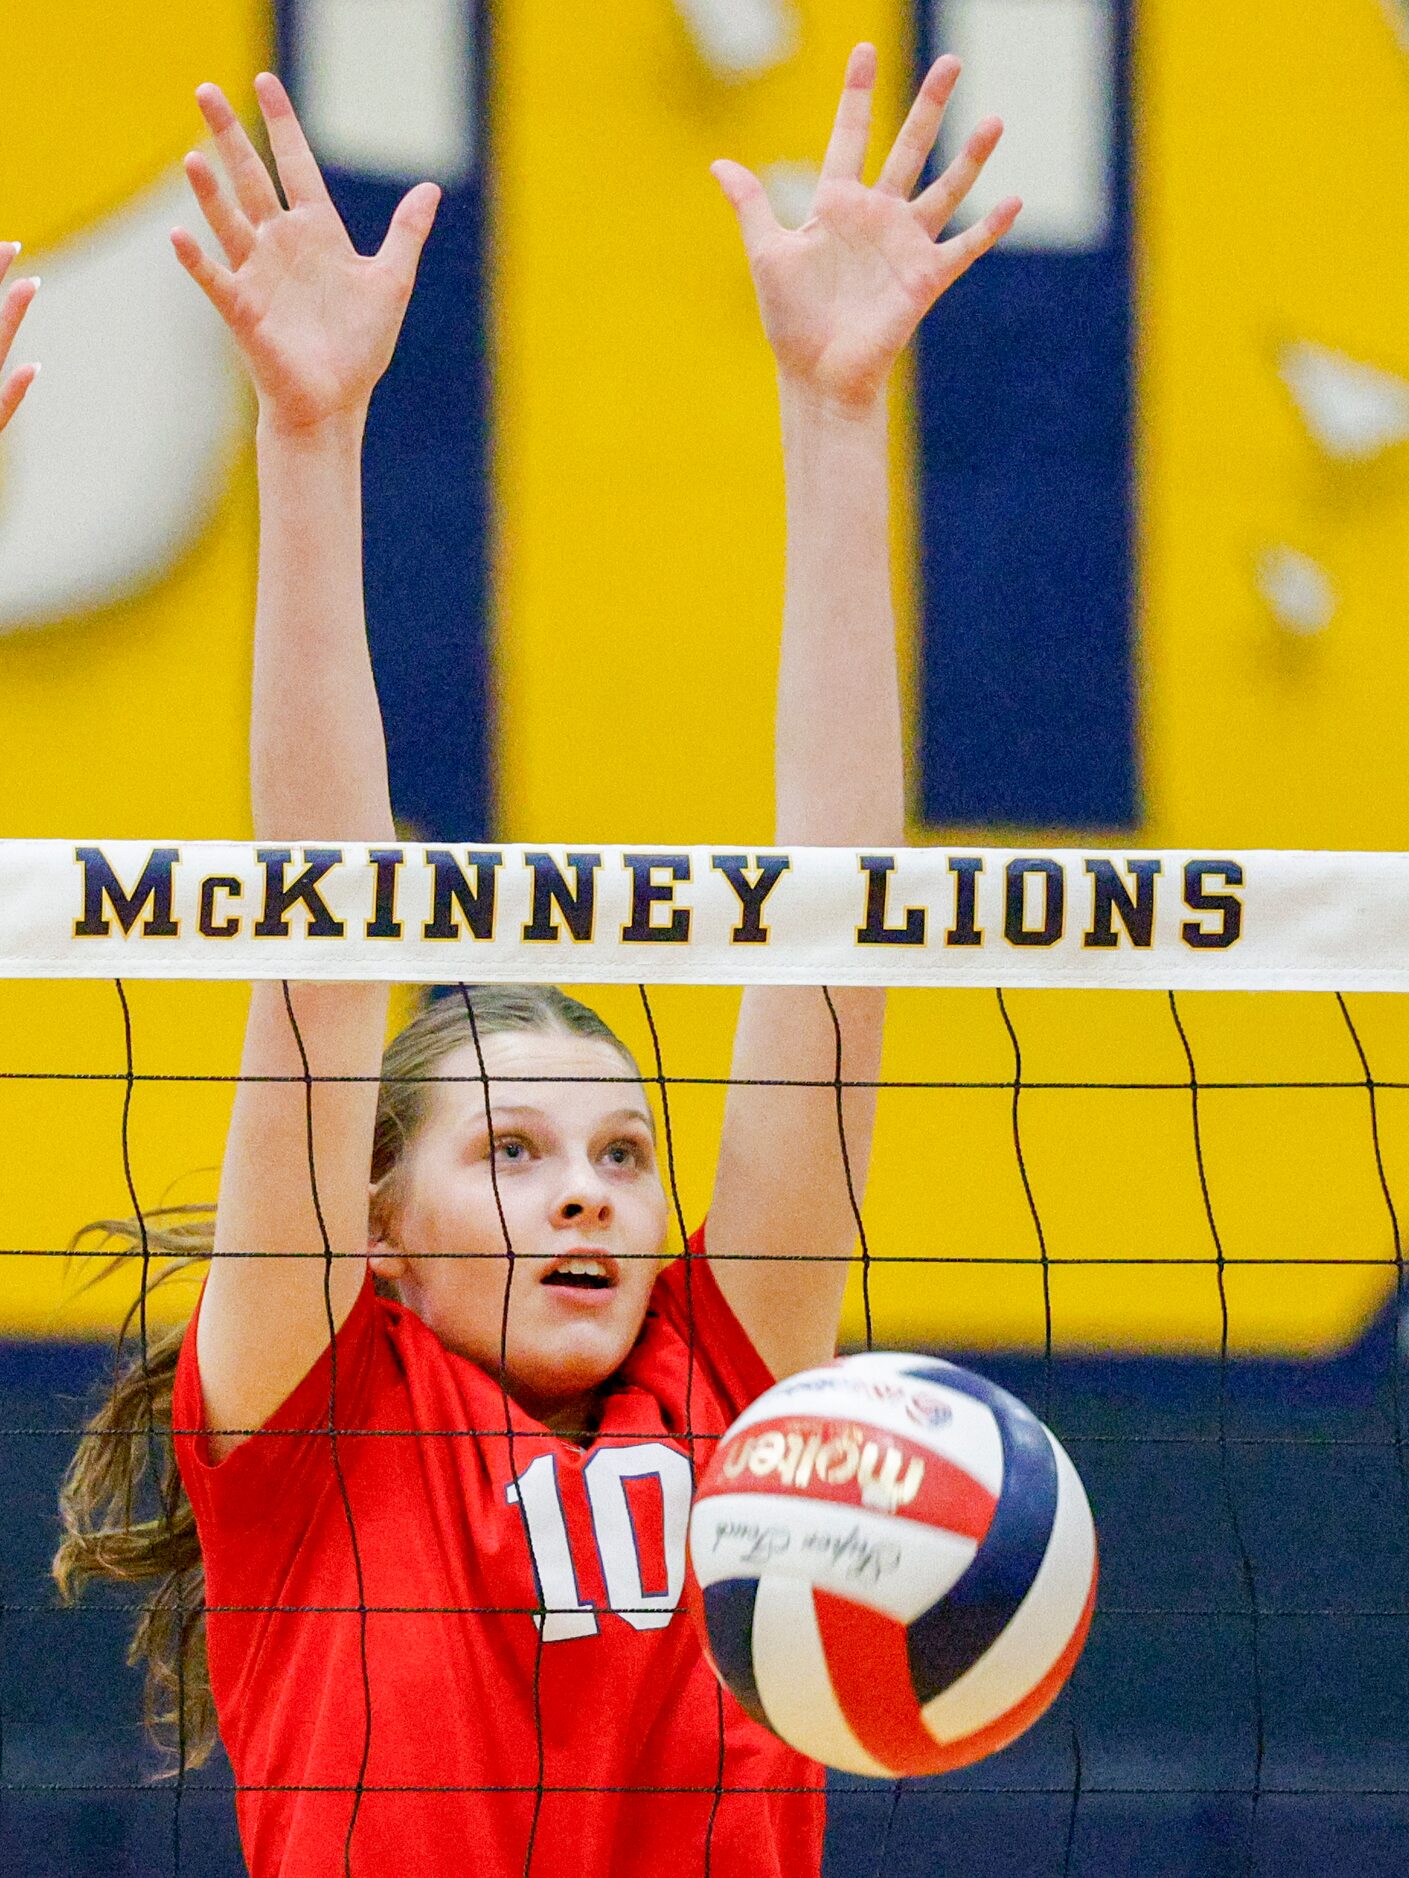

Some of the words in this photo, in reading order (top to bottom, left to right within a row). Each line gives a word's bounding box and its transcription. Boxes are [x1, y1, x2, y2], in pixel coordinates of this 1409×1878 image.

[72, 846, 792, 945] McKINNEY
[855, 855, 1246, 951] LIONS
[723, 1430, 925, 1508] molten
[505, 1442, 694, 1643] 10
